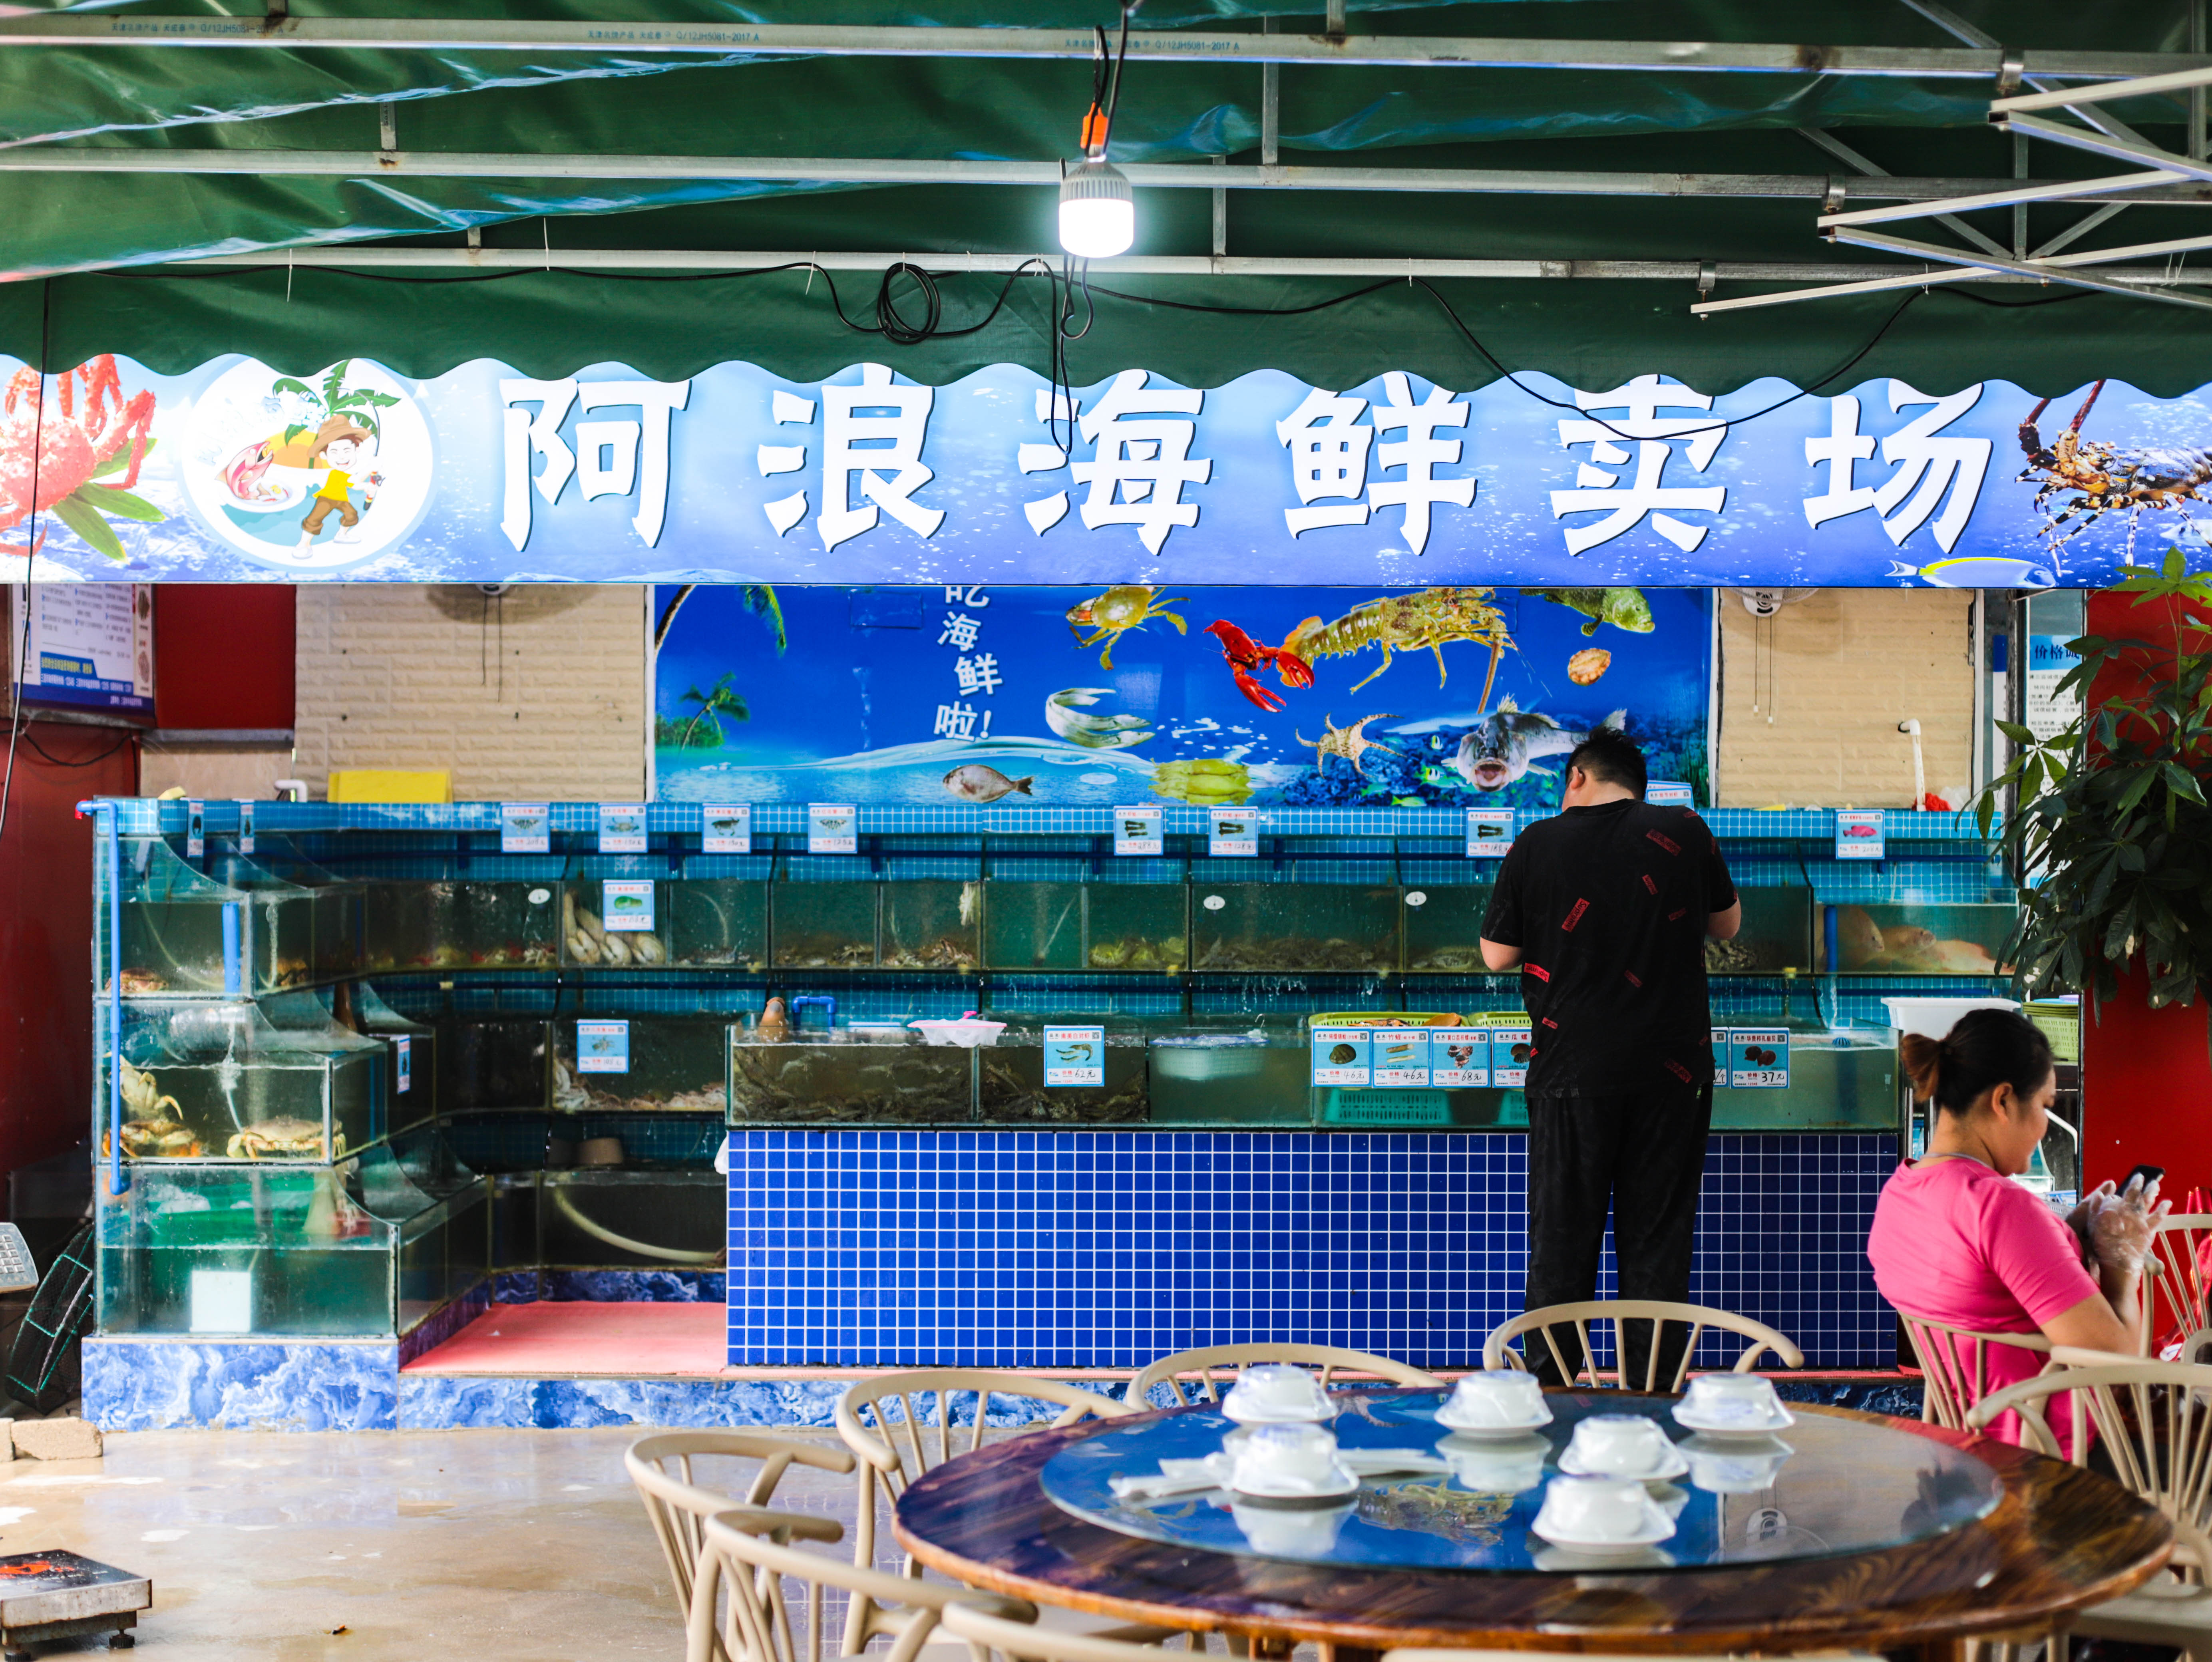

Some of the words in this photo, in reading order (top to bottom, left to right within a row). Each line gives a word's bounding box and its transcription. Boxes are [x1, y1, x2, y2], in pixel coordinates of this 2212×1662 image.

[676, 31, 750, 42] Q/12JH5081-2017
[499, 363, 1992, 556] 阿浪海鲜卖场
[1075, 1068, 1096, 1079] 62元
[1344, 1070, 1365, 1080] 46元
[1403, 1069, 1425, 1080] 46元
[1461, 1070, 1482, 1081] 68元
[1762, 1072, 1784, 1083] 37元
